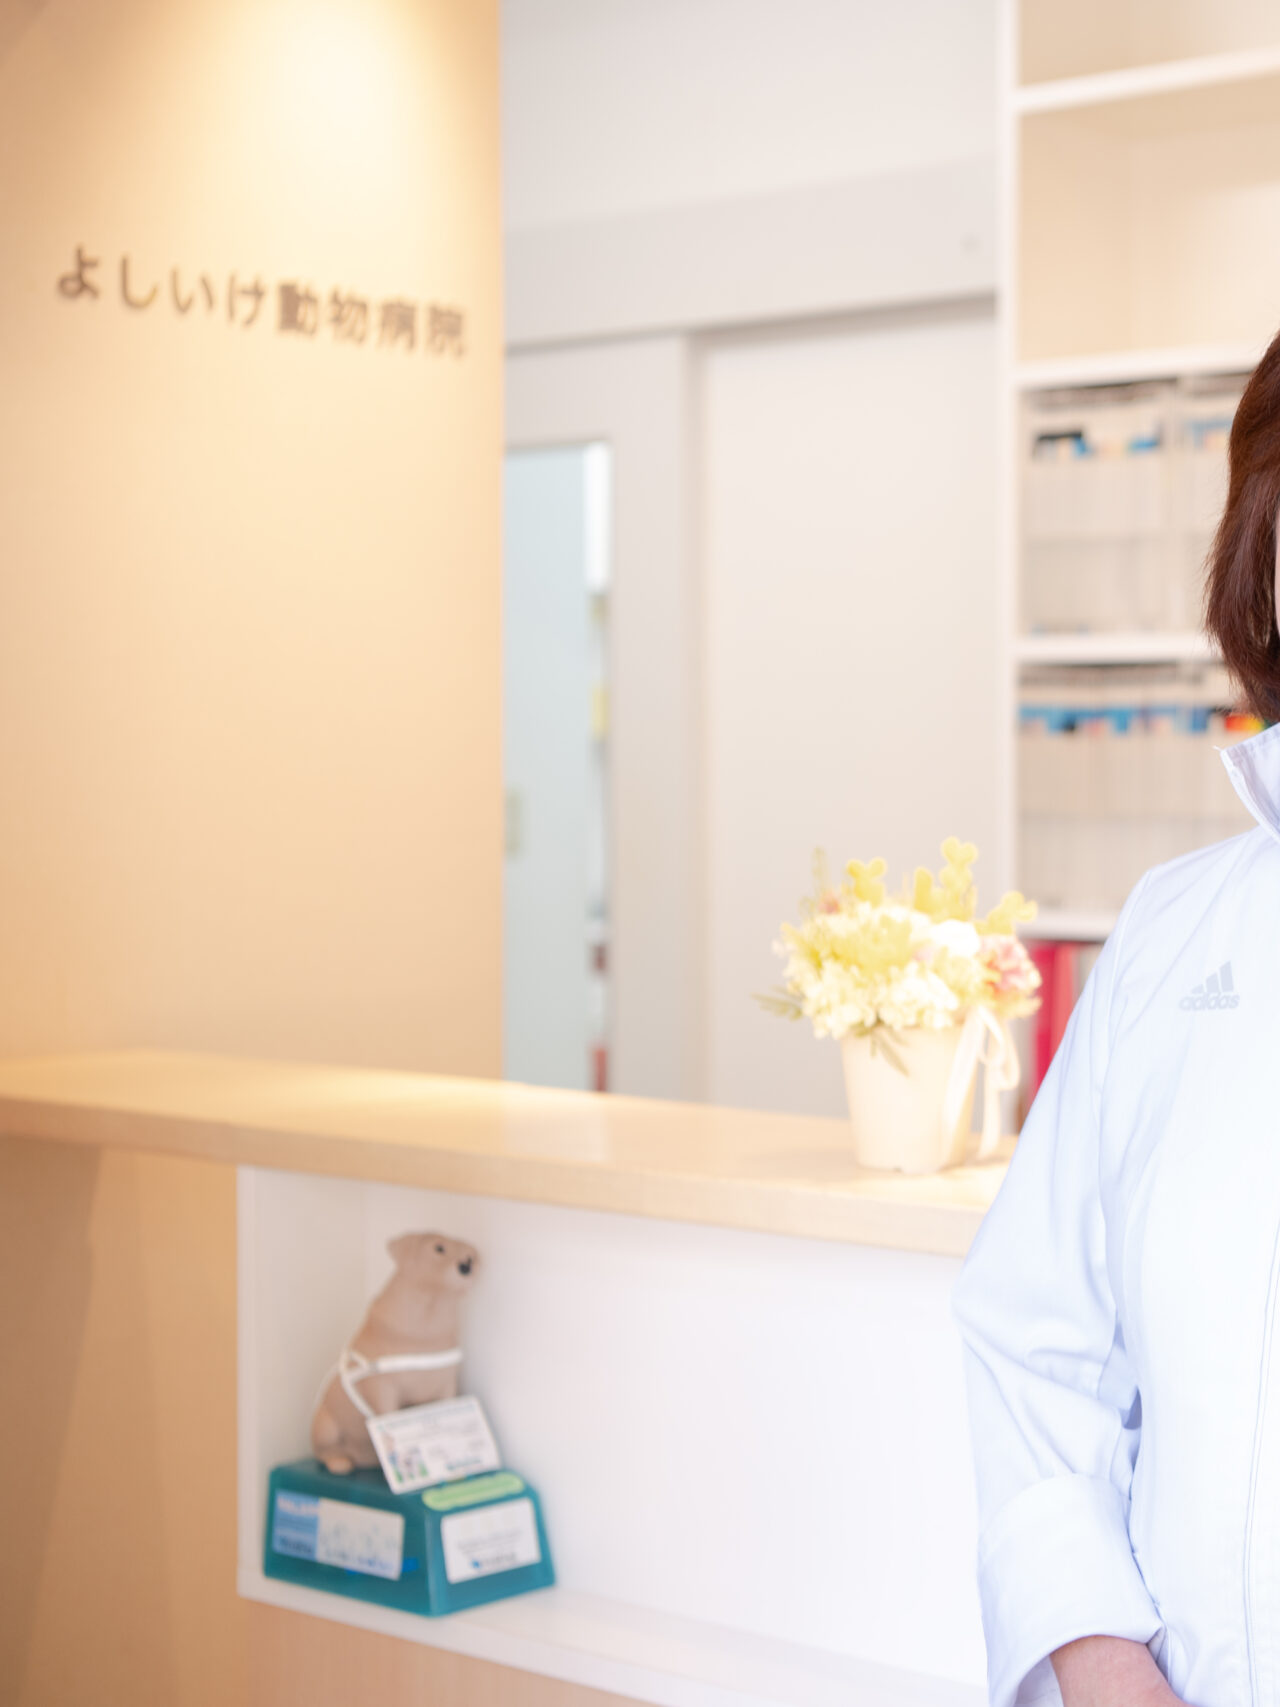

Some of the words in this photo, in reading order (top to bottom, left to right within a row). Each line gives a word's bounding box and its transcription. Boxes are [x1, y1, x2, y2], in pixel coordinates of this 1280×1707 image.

[56, 242, 468, 358] よしいけ動物病院
[1178, 991, 1240, 1012] adidas
